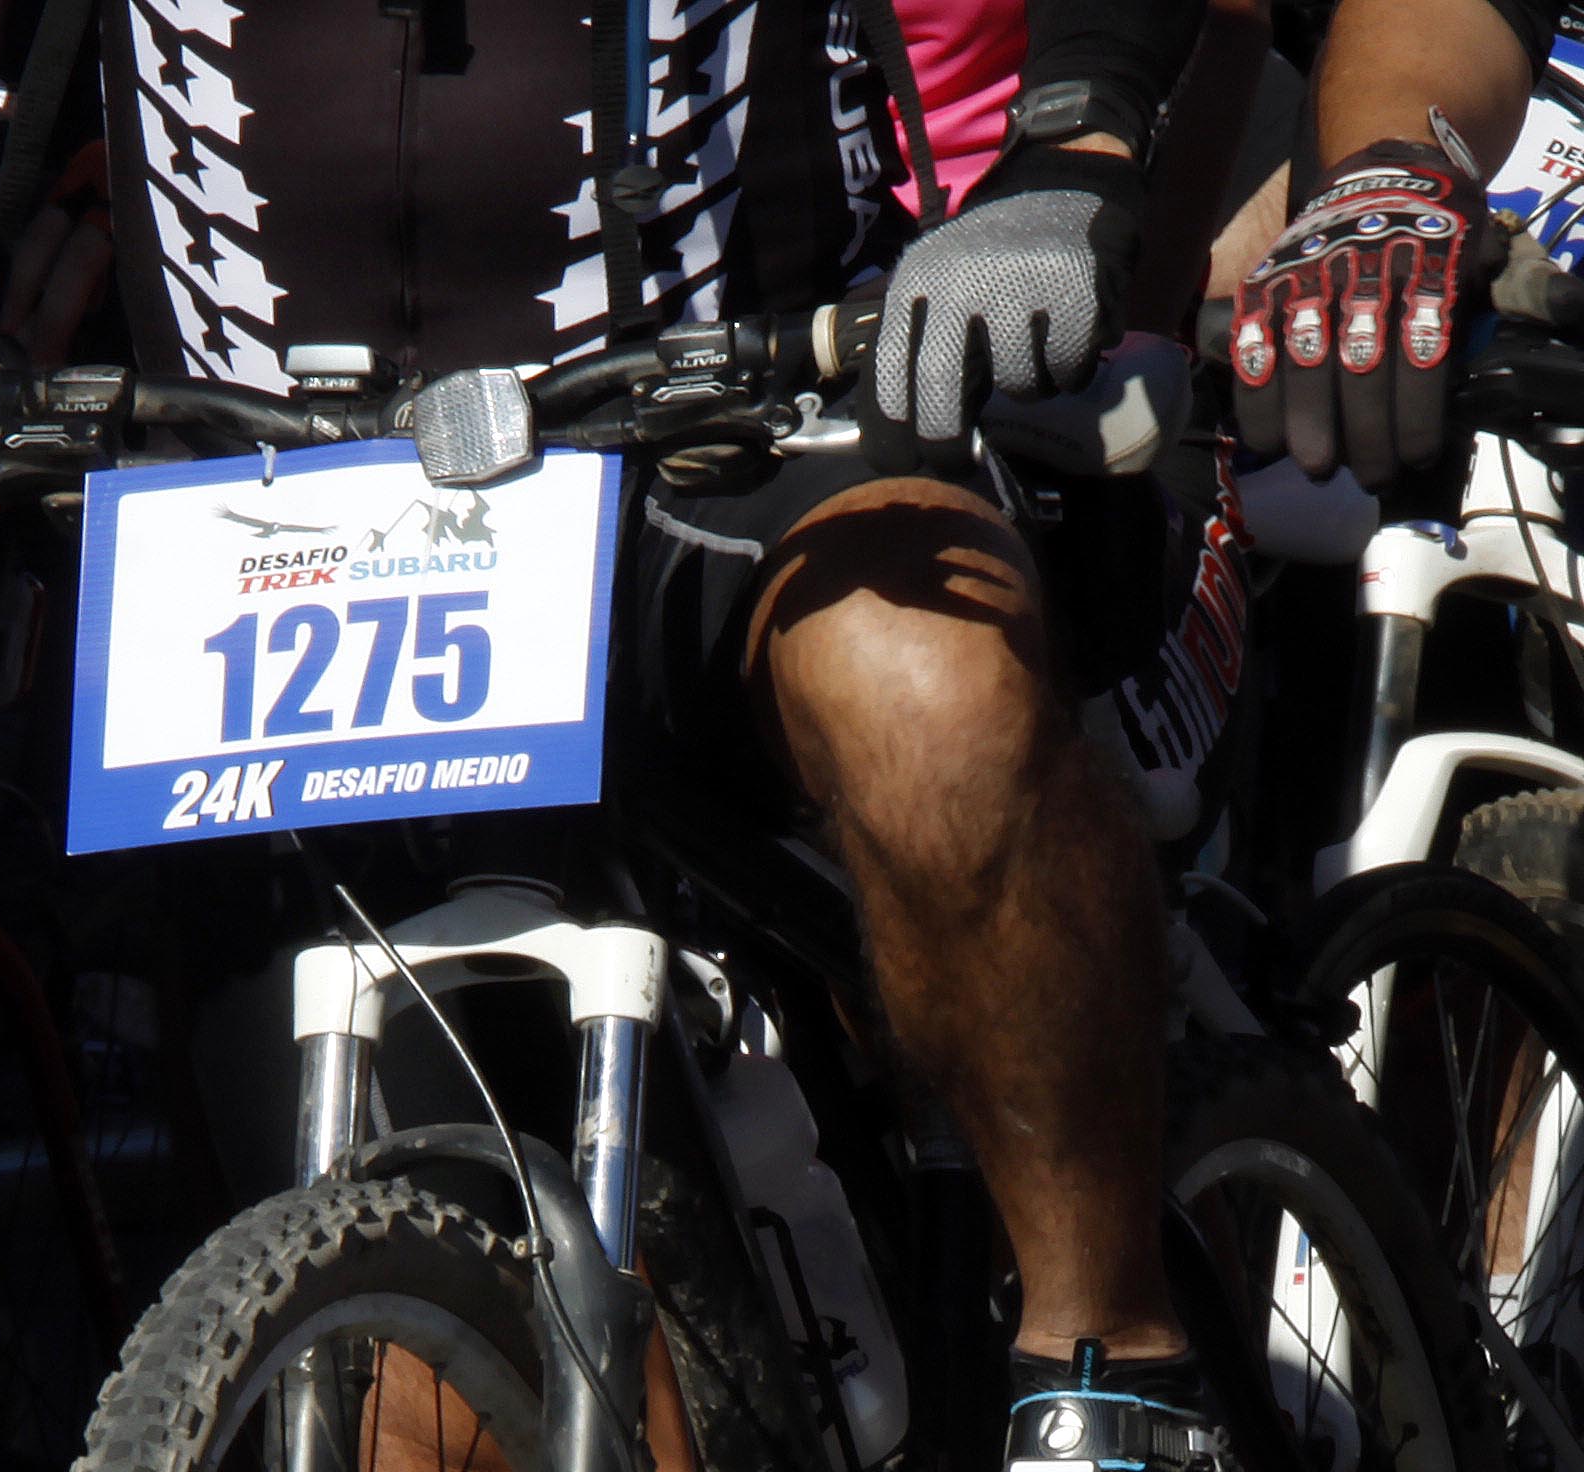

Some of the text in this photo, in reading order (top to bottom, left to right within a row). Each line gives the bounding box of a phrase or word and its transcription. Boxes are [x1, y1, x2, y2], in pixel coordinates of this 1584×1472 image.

[825, 0, 886, 288] SUBA
[671, 353, 728, 369] ALIVIO
[53, 401, 110, 413] ALIVIO
[237, 550, 499, 596] TREK SUBARU
[239, 545, 348, 576] DESAFIO
[204, 590, 492, 744] 1275
[162, 753, 530, 830] 24K DESAFIO MEDIO
